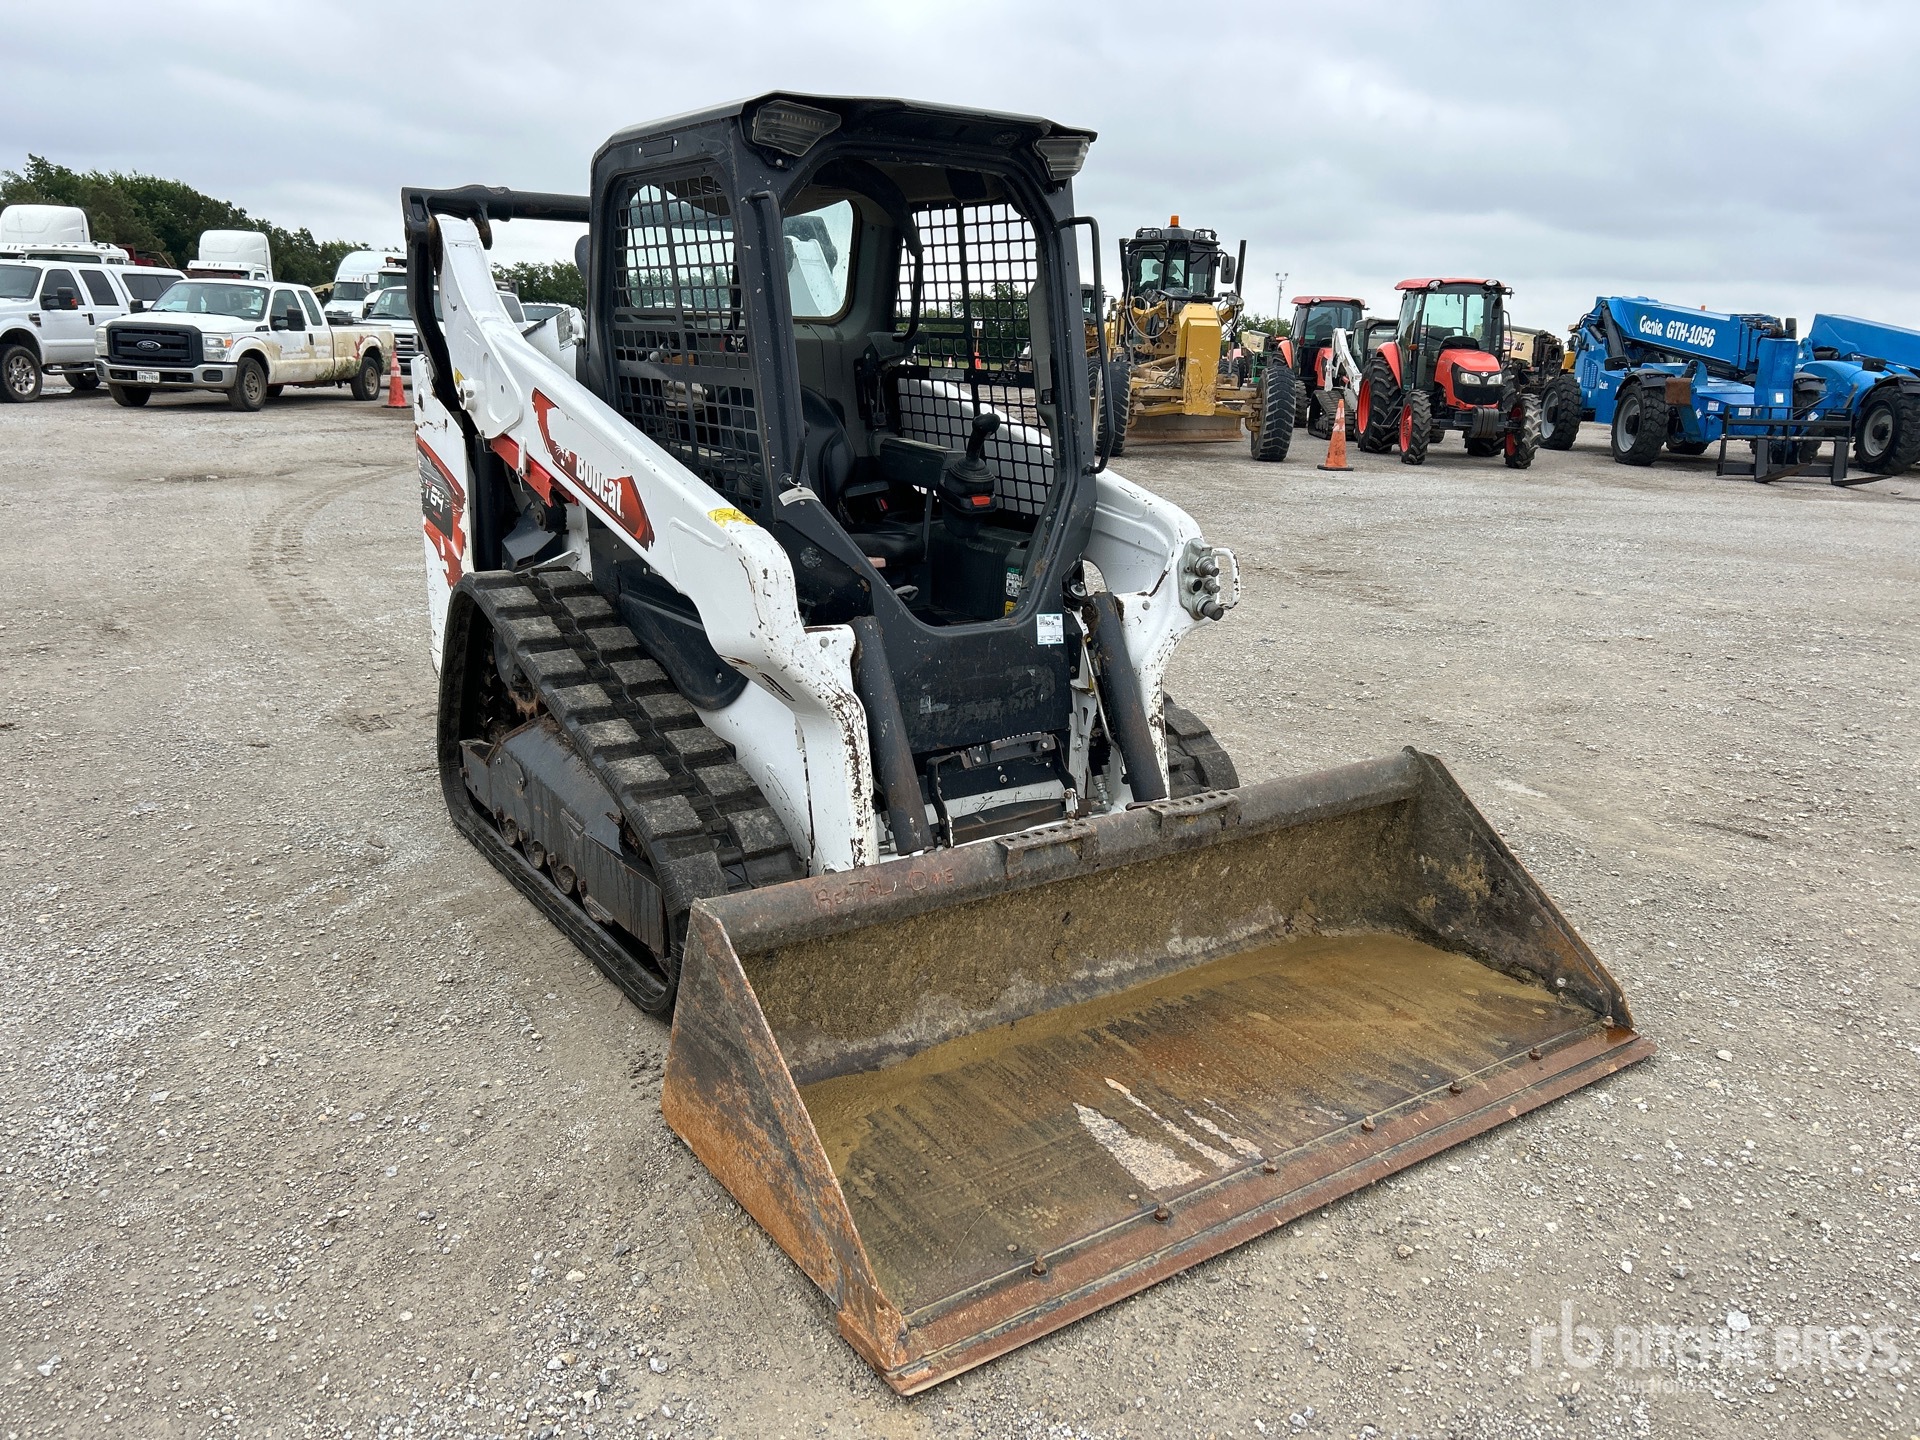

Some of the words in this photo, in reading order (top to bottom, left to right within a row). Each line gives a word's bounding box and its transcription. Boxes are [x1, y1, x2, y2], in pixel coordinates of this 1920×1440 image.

[1639, 314, 1663, 336] Genie
[1666, 320, 1716, 348] GTH-1056
[575, 455, 622, 517] Bobcat
